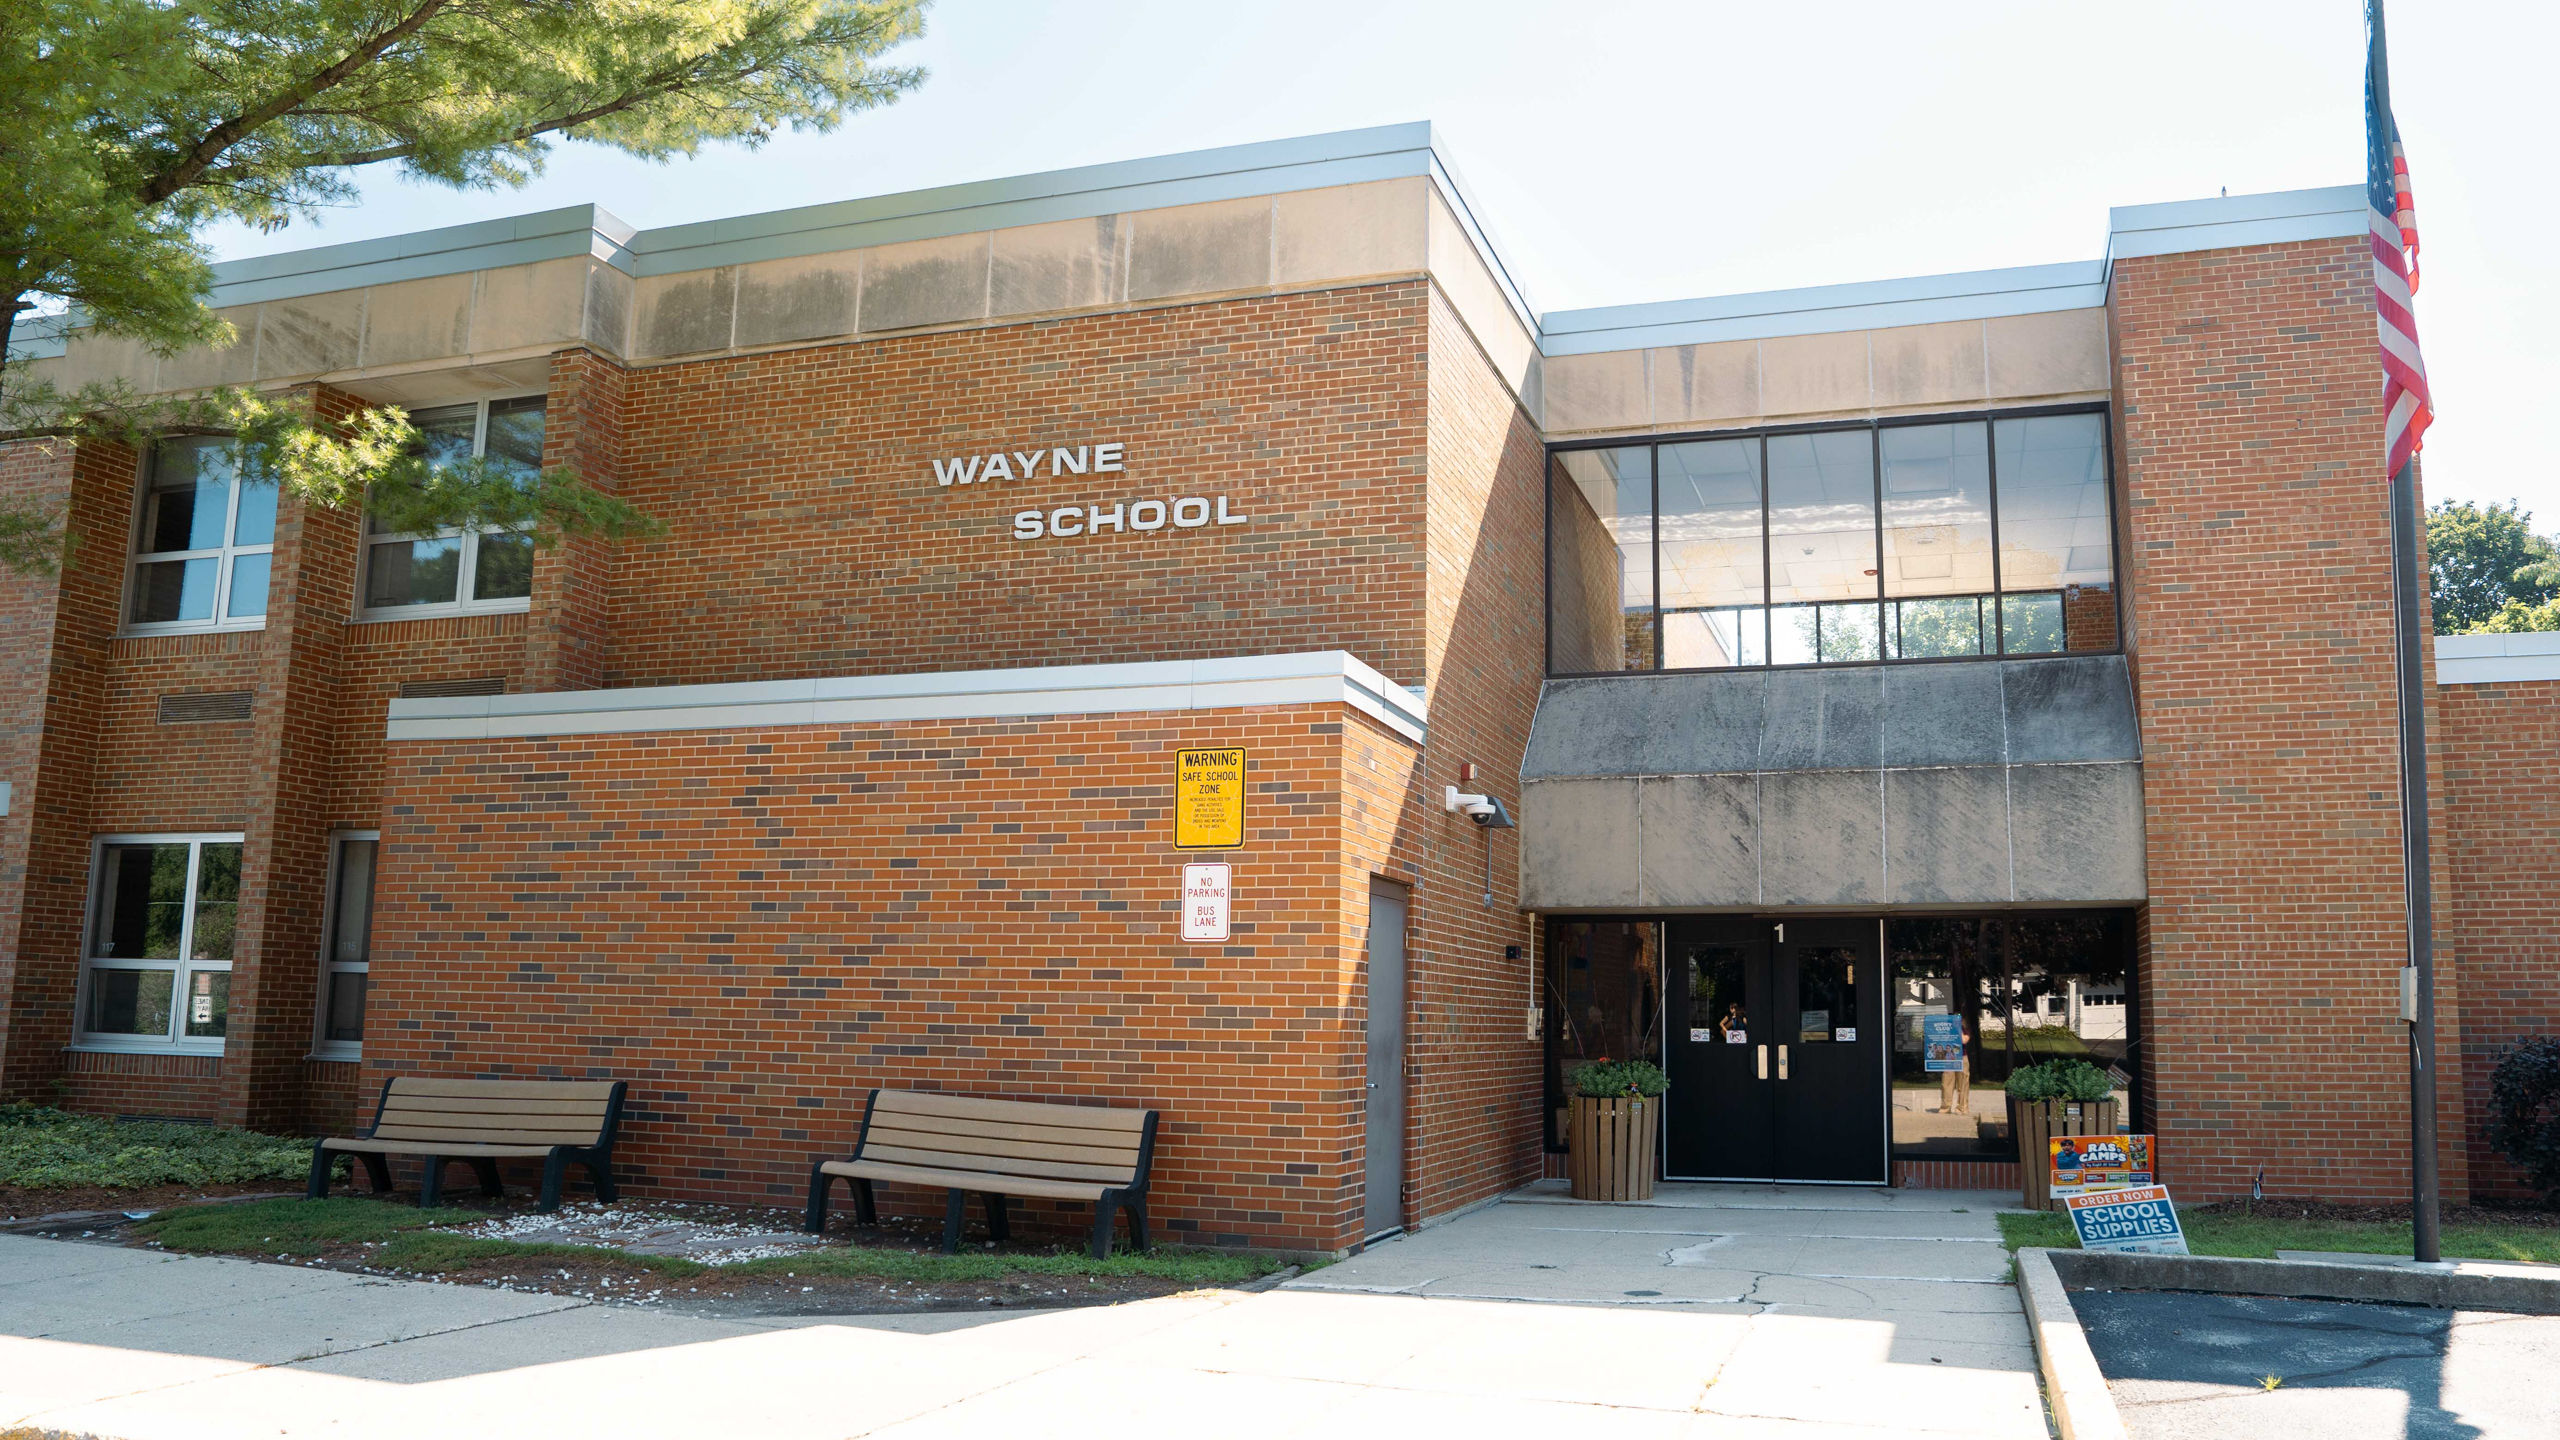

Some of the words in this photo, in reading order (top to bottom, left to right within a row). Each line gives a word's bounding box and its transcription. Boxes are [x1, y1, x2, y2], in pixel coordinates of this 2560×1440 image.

[932, 442, 1127, 487] WAYNE
[1013, 495, 1248, 540] SCHOOL
[1185, 752, 1237, 767] WARNING
[1182, 772, 1202, 782] SAFE
[1206, 770, 1238, 781] SCHOOL
[1199, 784, 1220, 794] ZONE
[1200, 877, 1213, 887] NO
[1187, 888, 1225, 898] PARKING
[1197, 906, 1215, 916] BUS
[1194, 917, 1217, 927] LANE
[1774, 923, 1784, 943] 1
[102, 942, 115, 952] 117
[342, 941, 356, 951] 115
[2088, 1143, 2116, 1152] RAS
[2079, 1152, 2127, 1162] CAMPS
[2079, 1195, 2120, 1206] ORDER
[2124, 1190, 2154, 1201] NOW
[2082, 1202, 2166, 1224] SCHOOL
[2084, 1218, 2173, 1240] SUPPLIES
